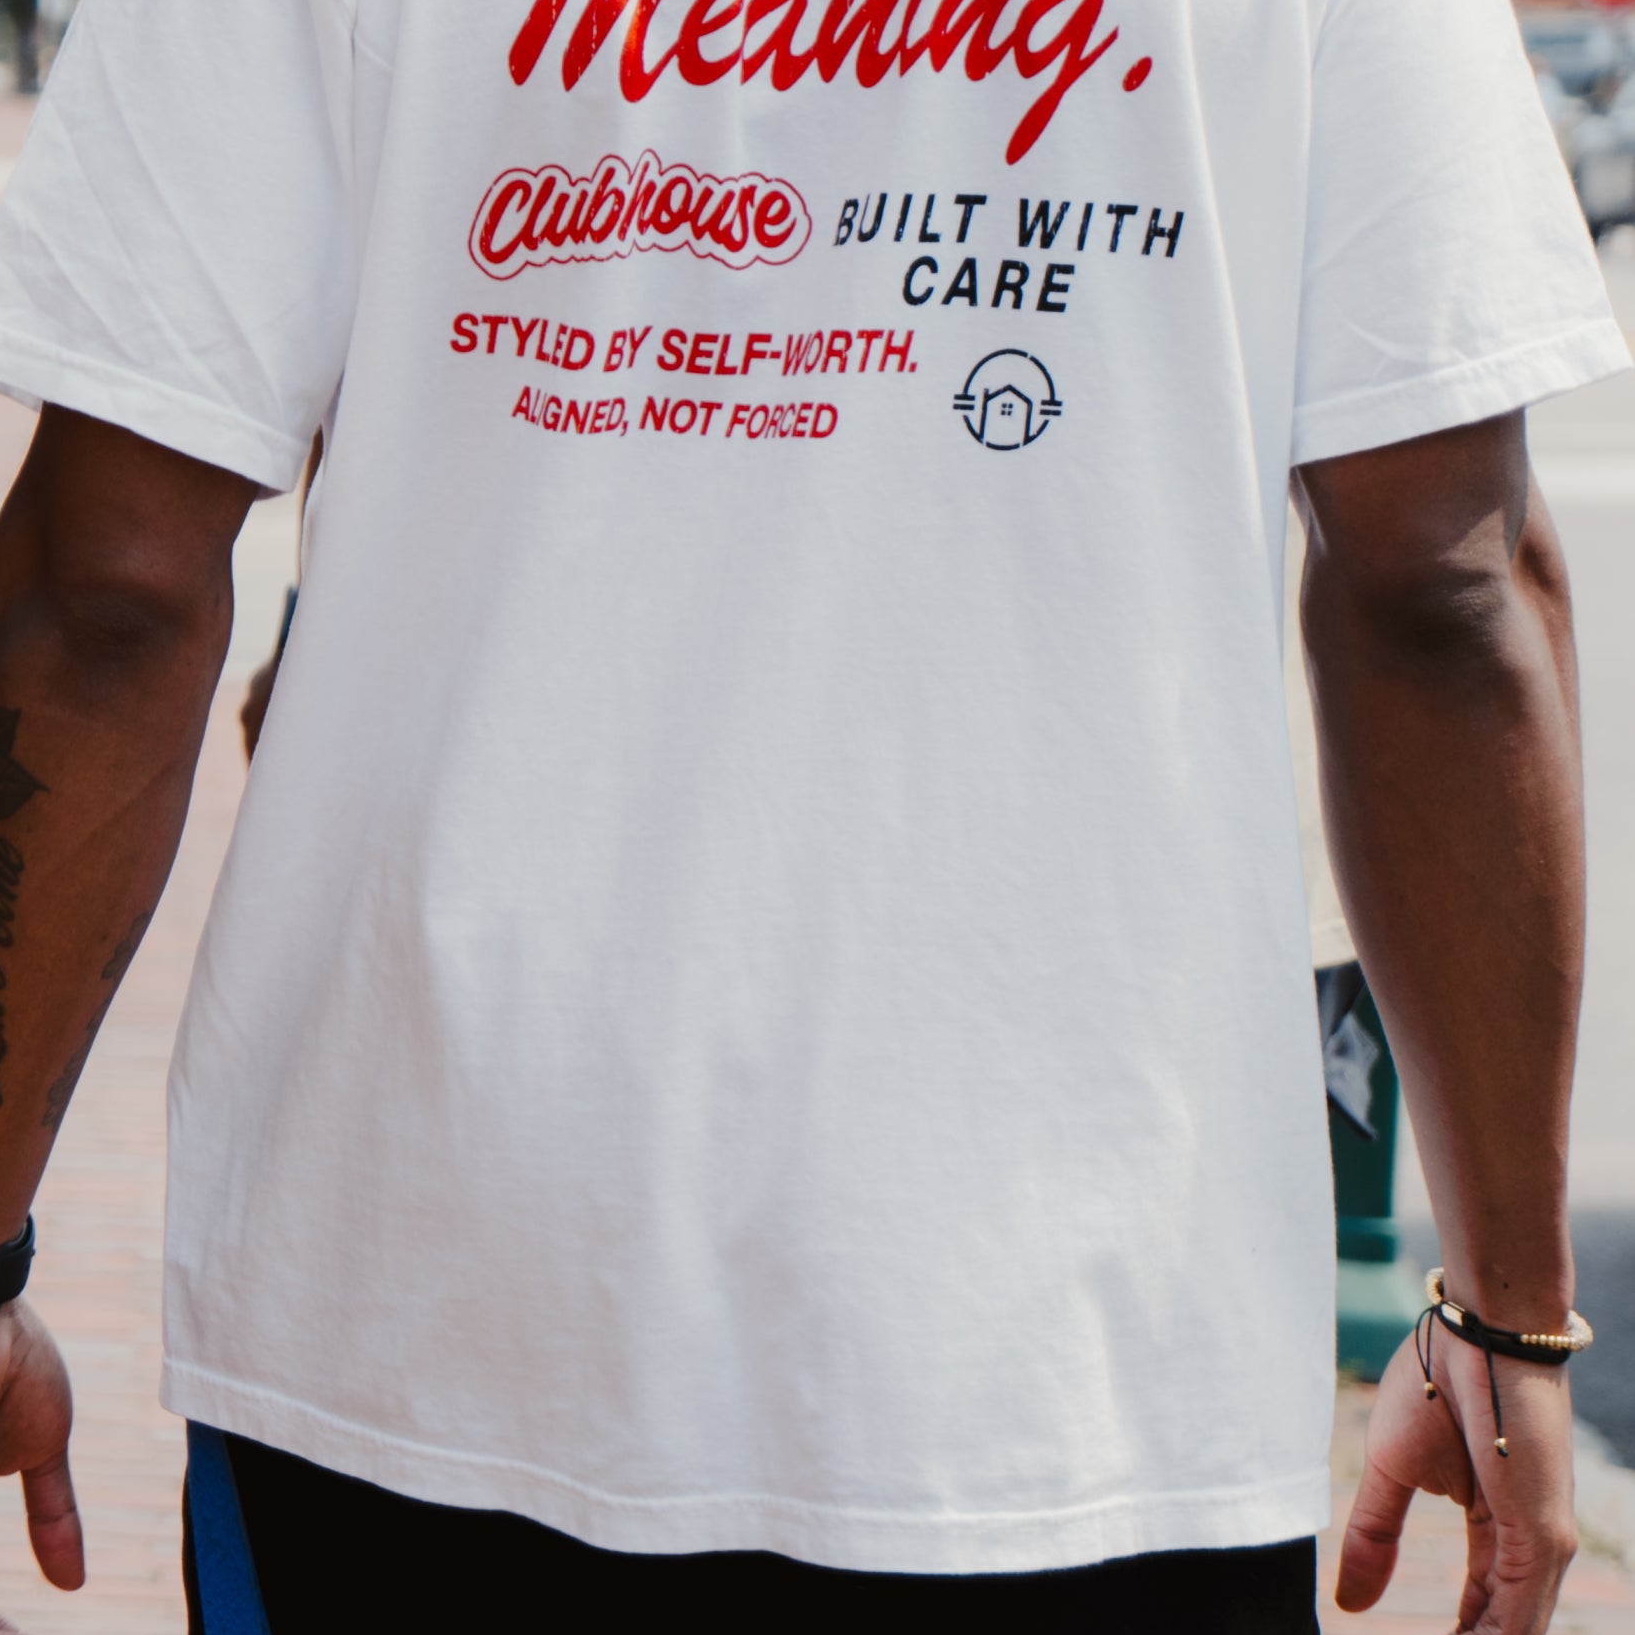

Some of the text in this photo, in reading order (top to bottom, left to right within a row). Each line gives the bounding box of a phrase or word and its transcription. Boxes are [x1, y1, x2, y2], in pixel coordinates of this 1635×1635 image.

[479, 160, 797, 264] Clubhouse
[833, 192, 1185, 258] BUILT WITH
[902, 255, 1075, 313] CARE
[449, 313, 918, 376] STYLED BY SELF-WORTH.
[511, 385, 839, 439] ALIGNED, NOT FORCED
